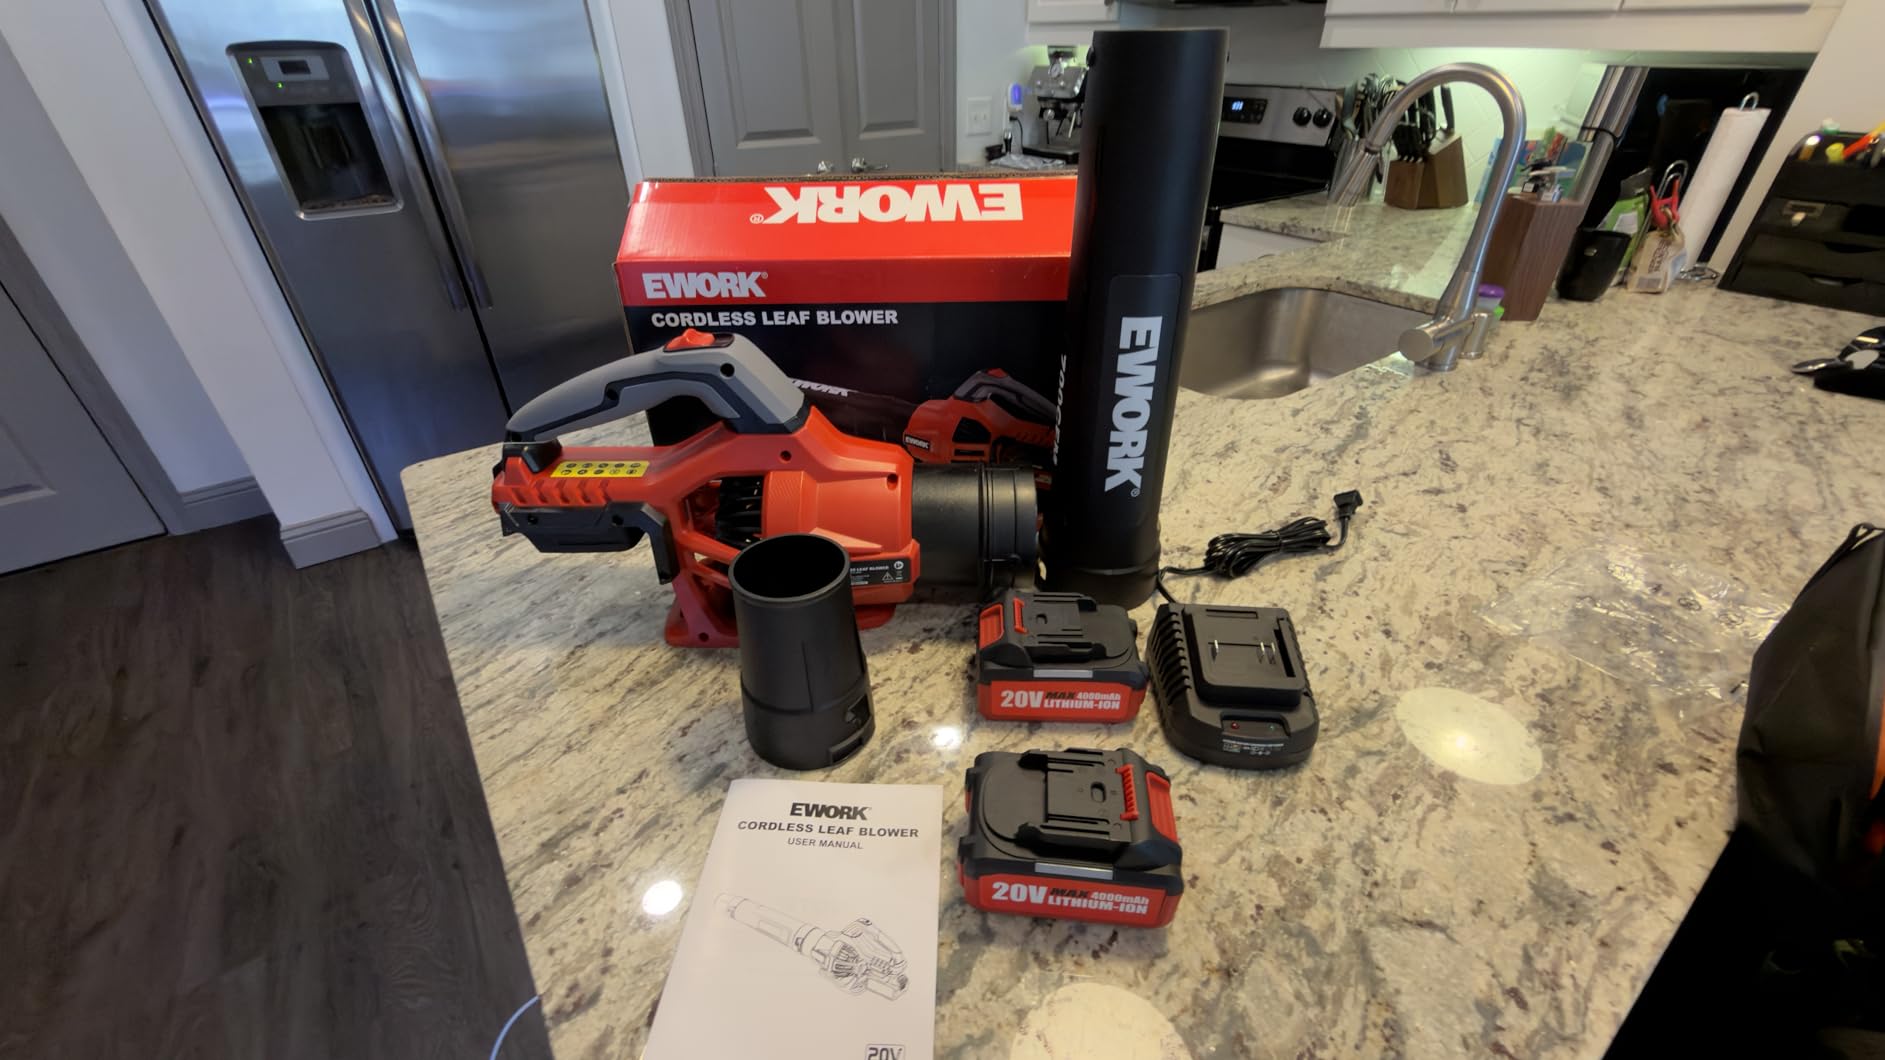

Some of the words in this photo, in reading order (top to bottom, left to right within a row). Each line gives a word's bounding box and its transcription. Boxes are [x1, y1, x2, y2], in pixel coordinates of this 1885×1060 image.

[651, 311, 757, 328] CORDLESS
[761, 310, 811, 326] LEAF
[816, 309, 899, 325] BLOWER
[1000, 690, 1044, 708] 20V
[1076, 691, 1121, 701] 4000mAh
[1043, 699, 1121, 710] LITHIUM-ION
[737, 820, 814, 833] CORDLESS
[818, 825, 855, 835] LEAF
[858, 827, 919, 838] BLOWER
[787, 837, 817, 847] USER
[818, 839, 864, 849] MANUAL
[991, 881, 1048, 904] 20V
[1090, 891, 1150, 905] 4000mAh
[1047, 895, 1149, 914] LITHIUM-ION
